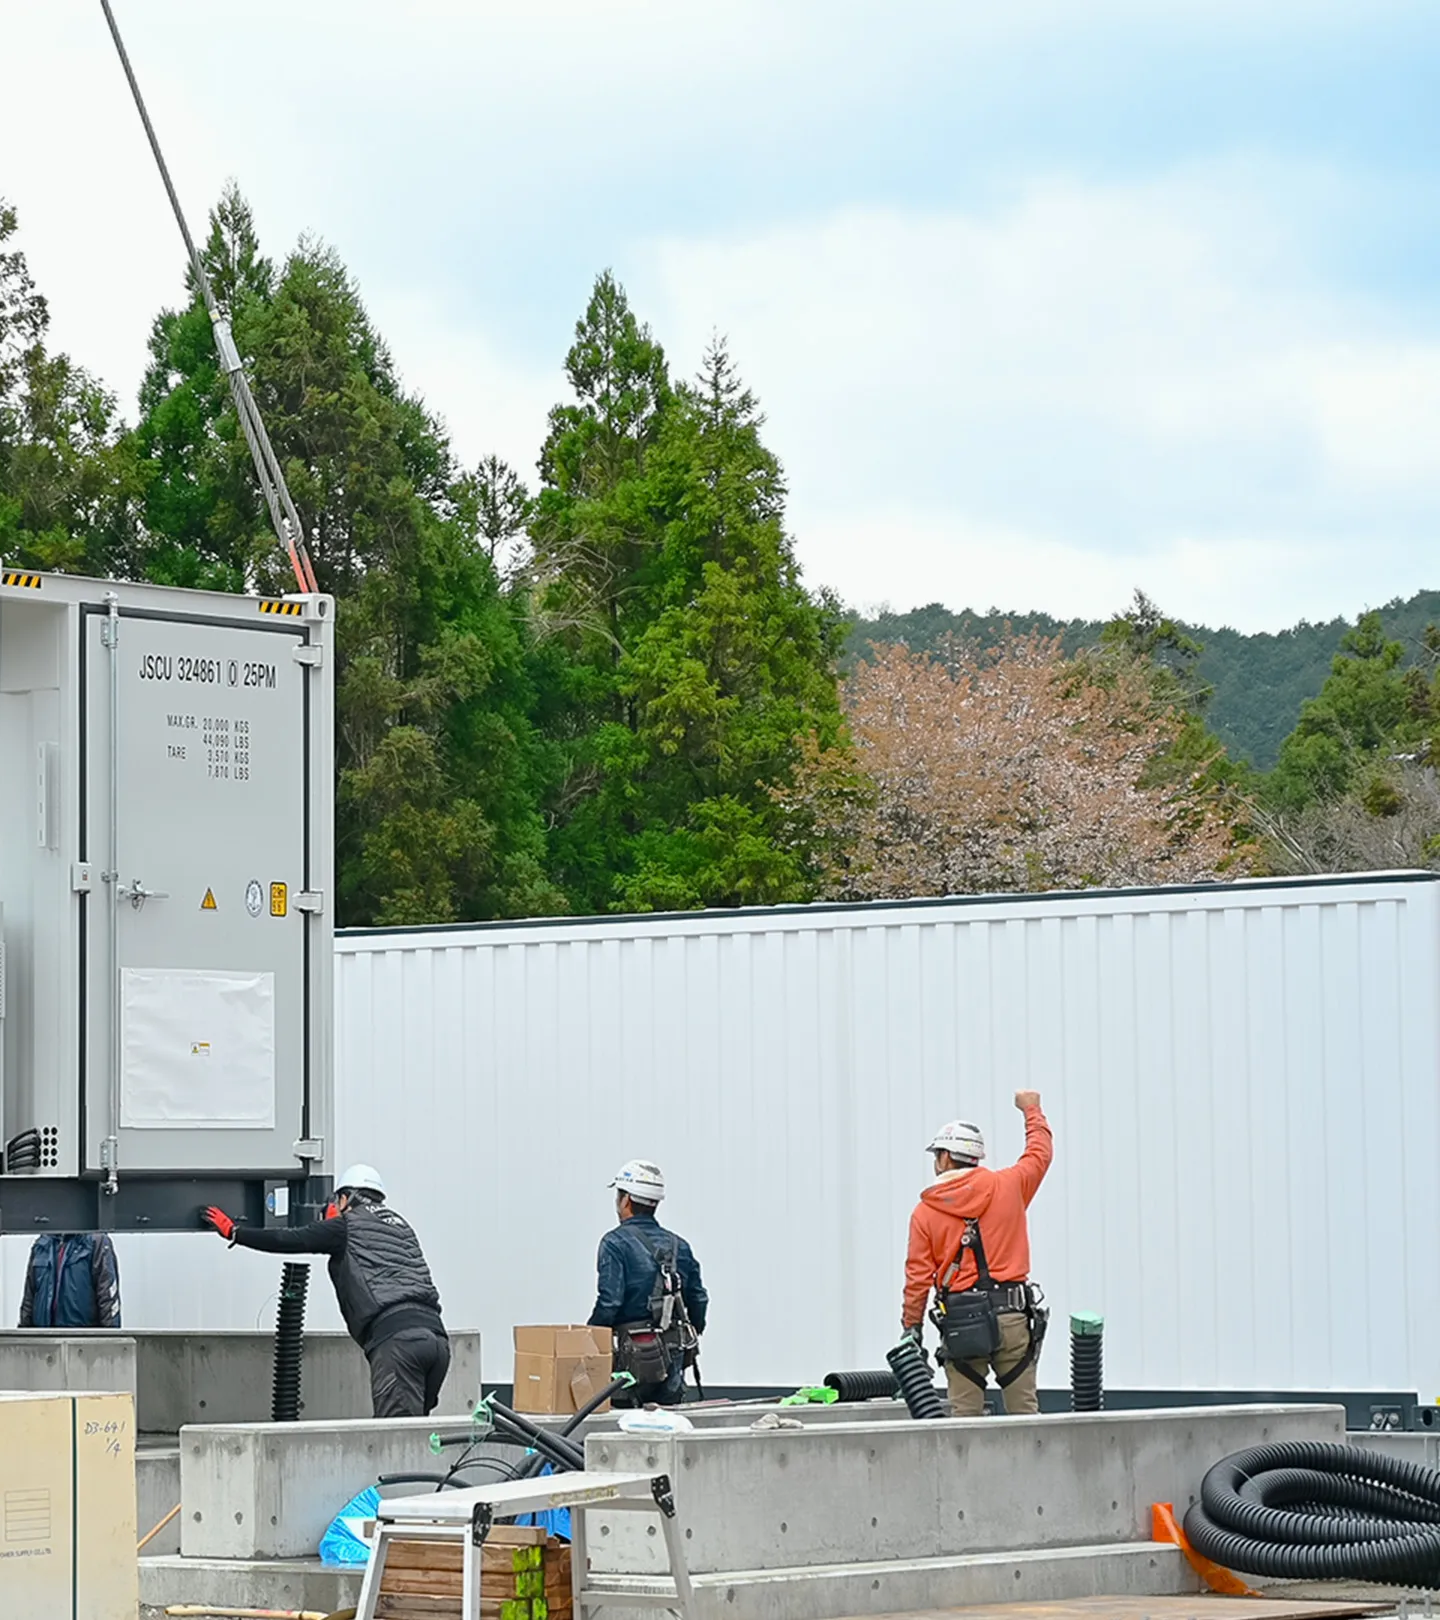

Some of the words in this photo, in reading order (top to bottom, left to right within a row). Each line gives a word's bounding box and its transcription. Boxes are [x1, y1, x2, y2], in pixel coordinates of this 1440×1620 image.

[140, 655, 172, 680] JSCU
[177, 657, 221, 684] 324861
[243, 662, 276, 689] 25PM
[234, 720, 250, 734] KGS
[234, 735, 250, 750] LBS
[167, 745, 186, 760] TARE
[234, 751, 250, 765] KGS
[234, 767, 250, 781] LBS
